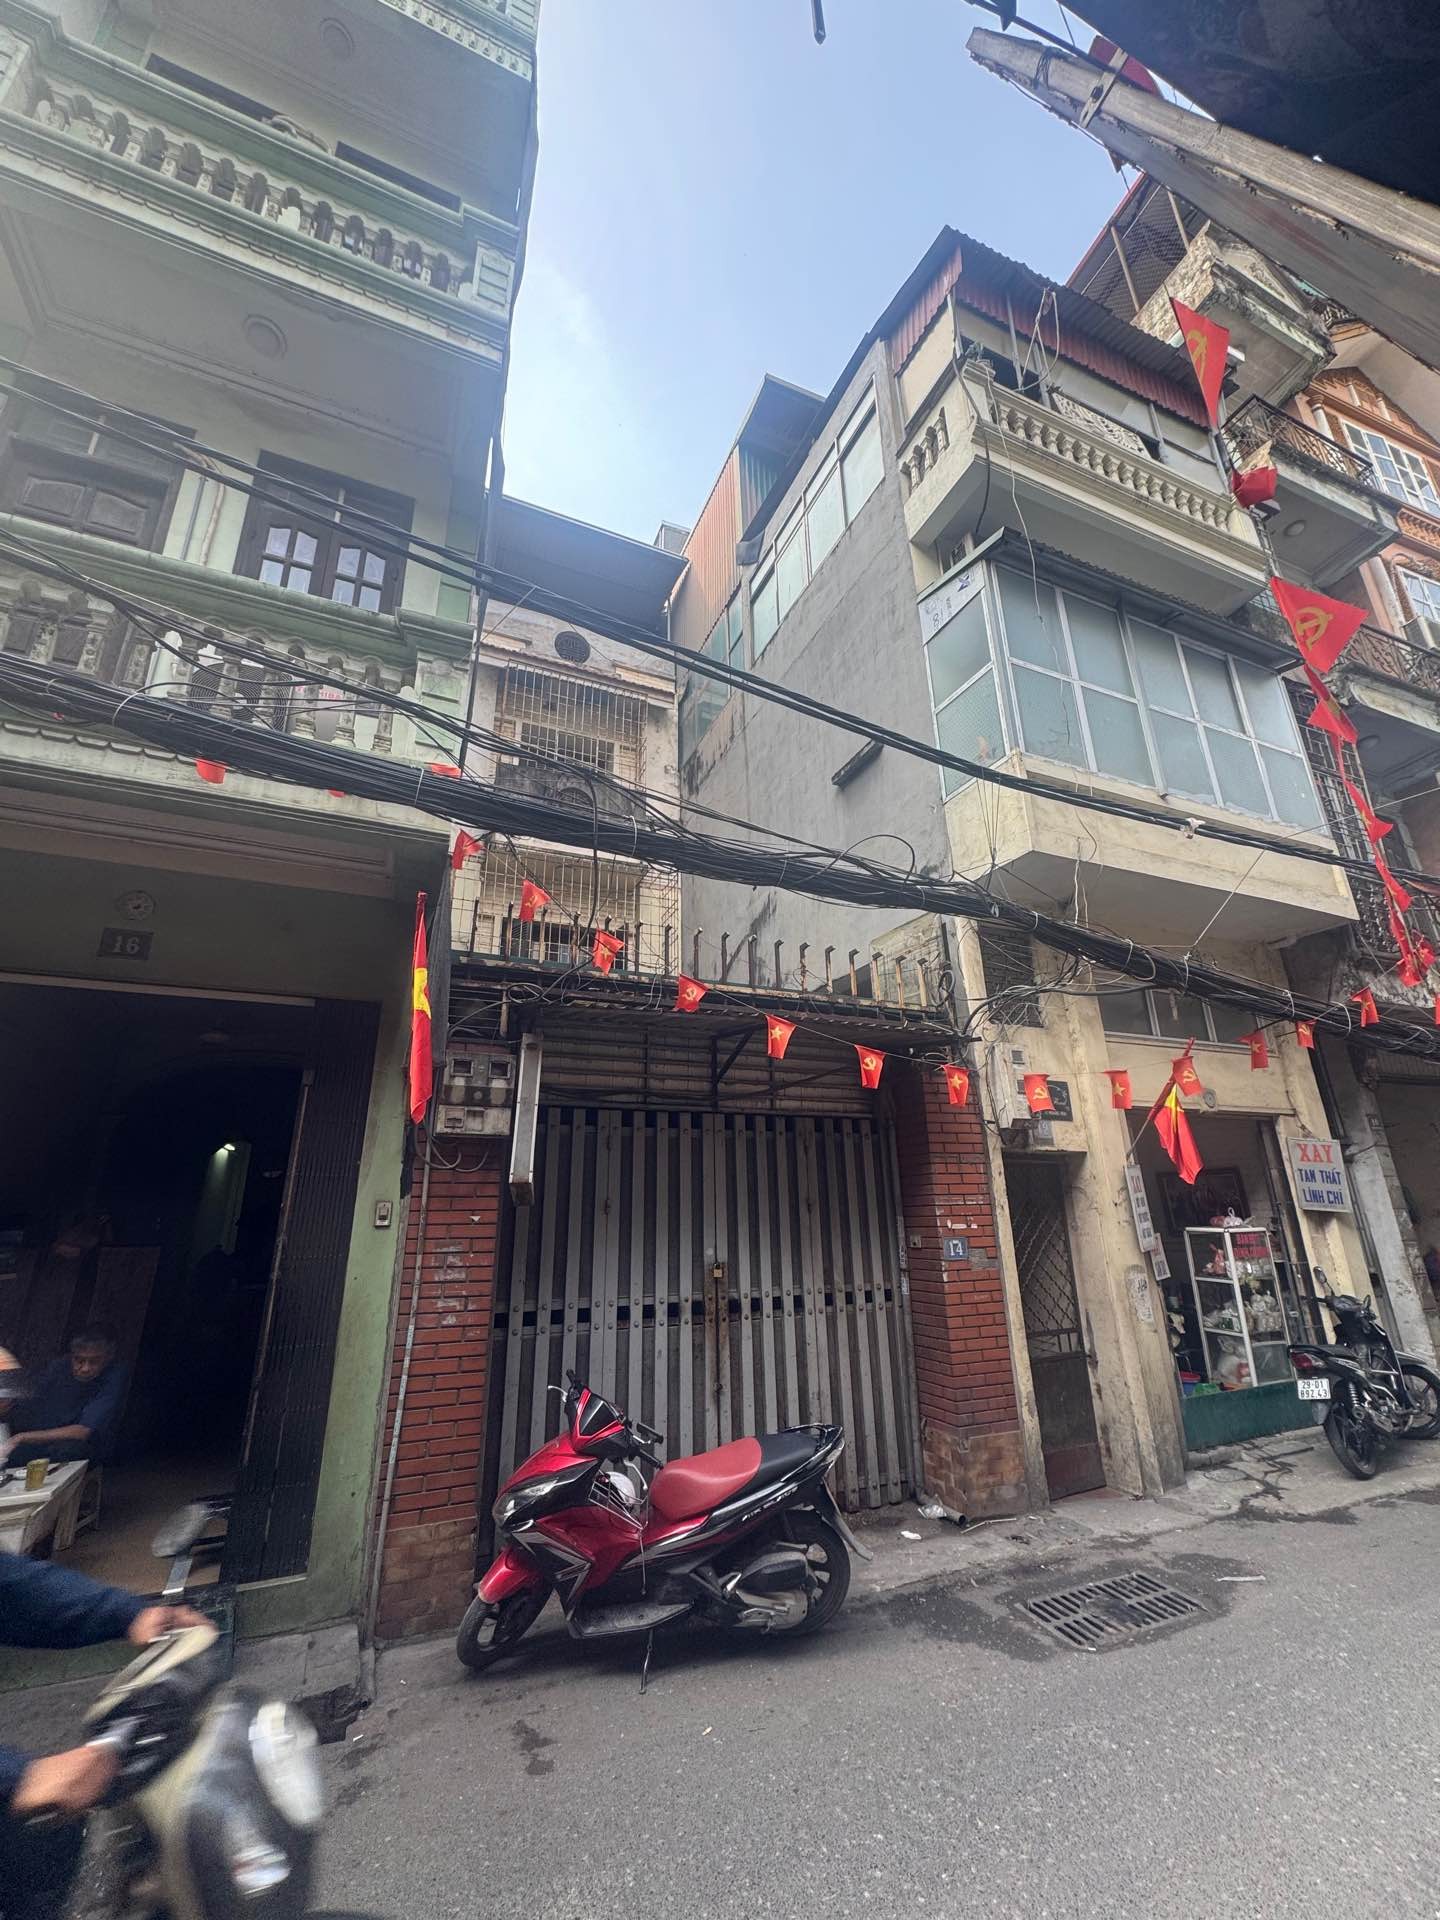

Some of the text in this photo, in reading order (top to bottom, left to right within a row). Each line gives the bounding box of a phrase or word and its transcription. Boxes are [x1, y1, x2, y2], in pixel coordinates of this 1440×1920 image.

[112, 936, 140, 954] 16
[1297, 1143, 1333, 1163] XAY
[949, 1240, 963, 1256] 14
